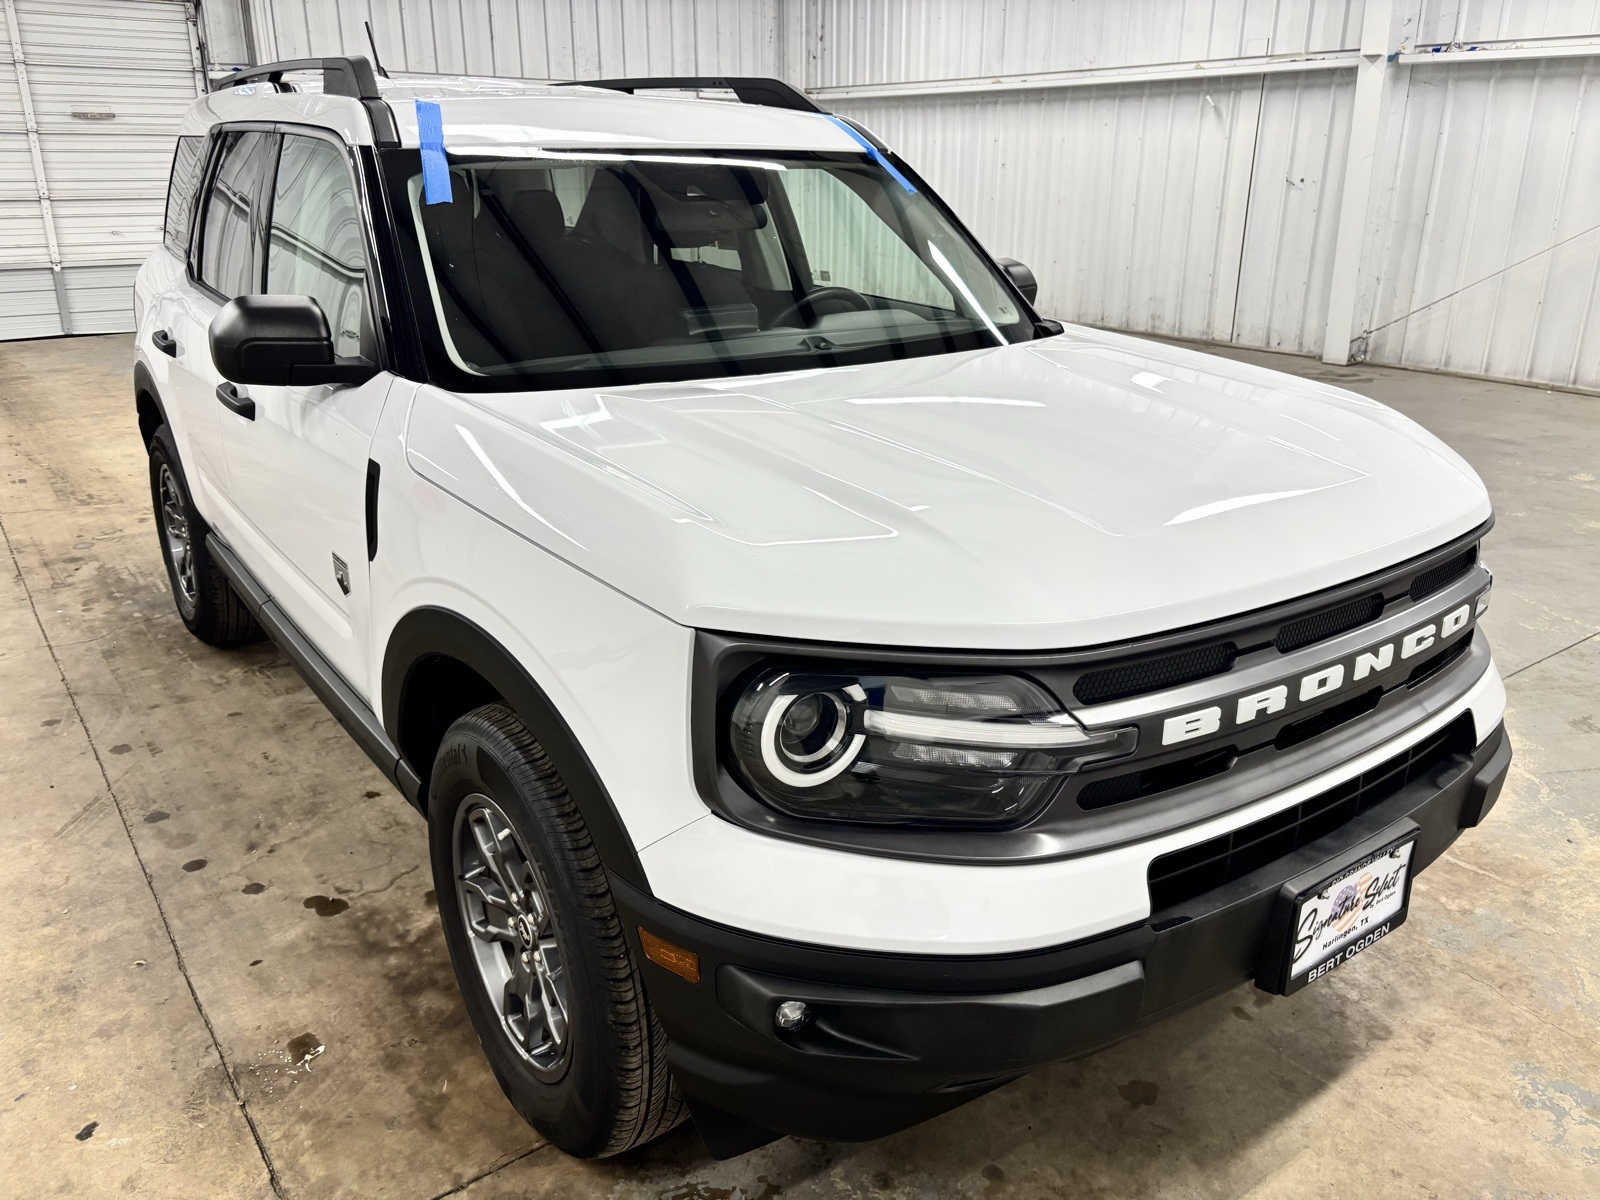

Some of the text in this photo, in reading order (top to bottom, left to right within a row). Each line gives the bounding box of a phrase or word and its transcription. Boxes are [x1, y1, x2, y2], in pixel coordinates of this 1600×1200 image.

[1162, 604, 1470, 746] BRONCO
[1293, 864, 1406, 963] Signature Select
[1308, 922, 1390, 983] BERT OGDEN
[1322, 916, 1370, 950] Harlingen, TX
